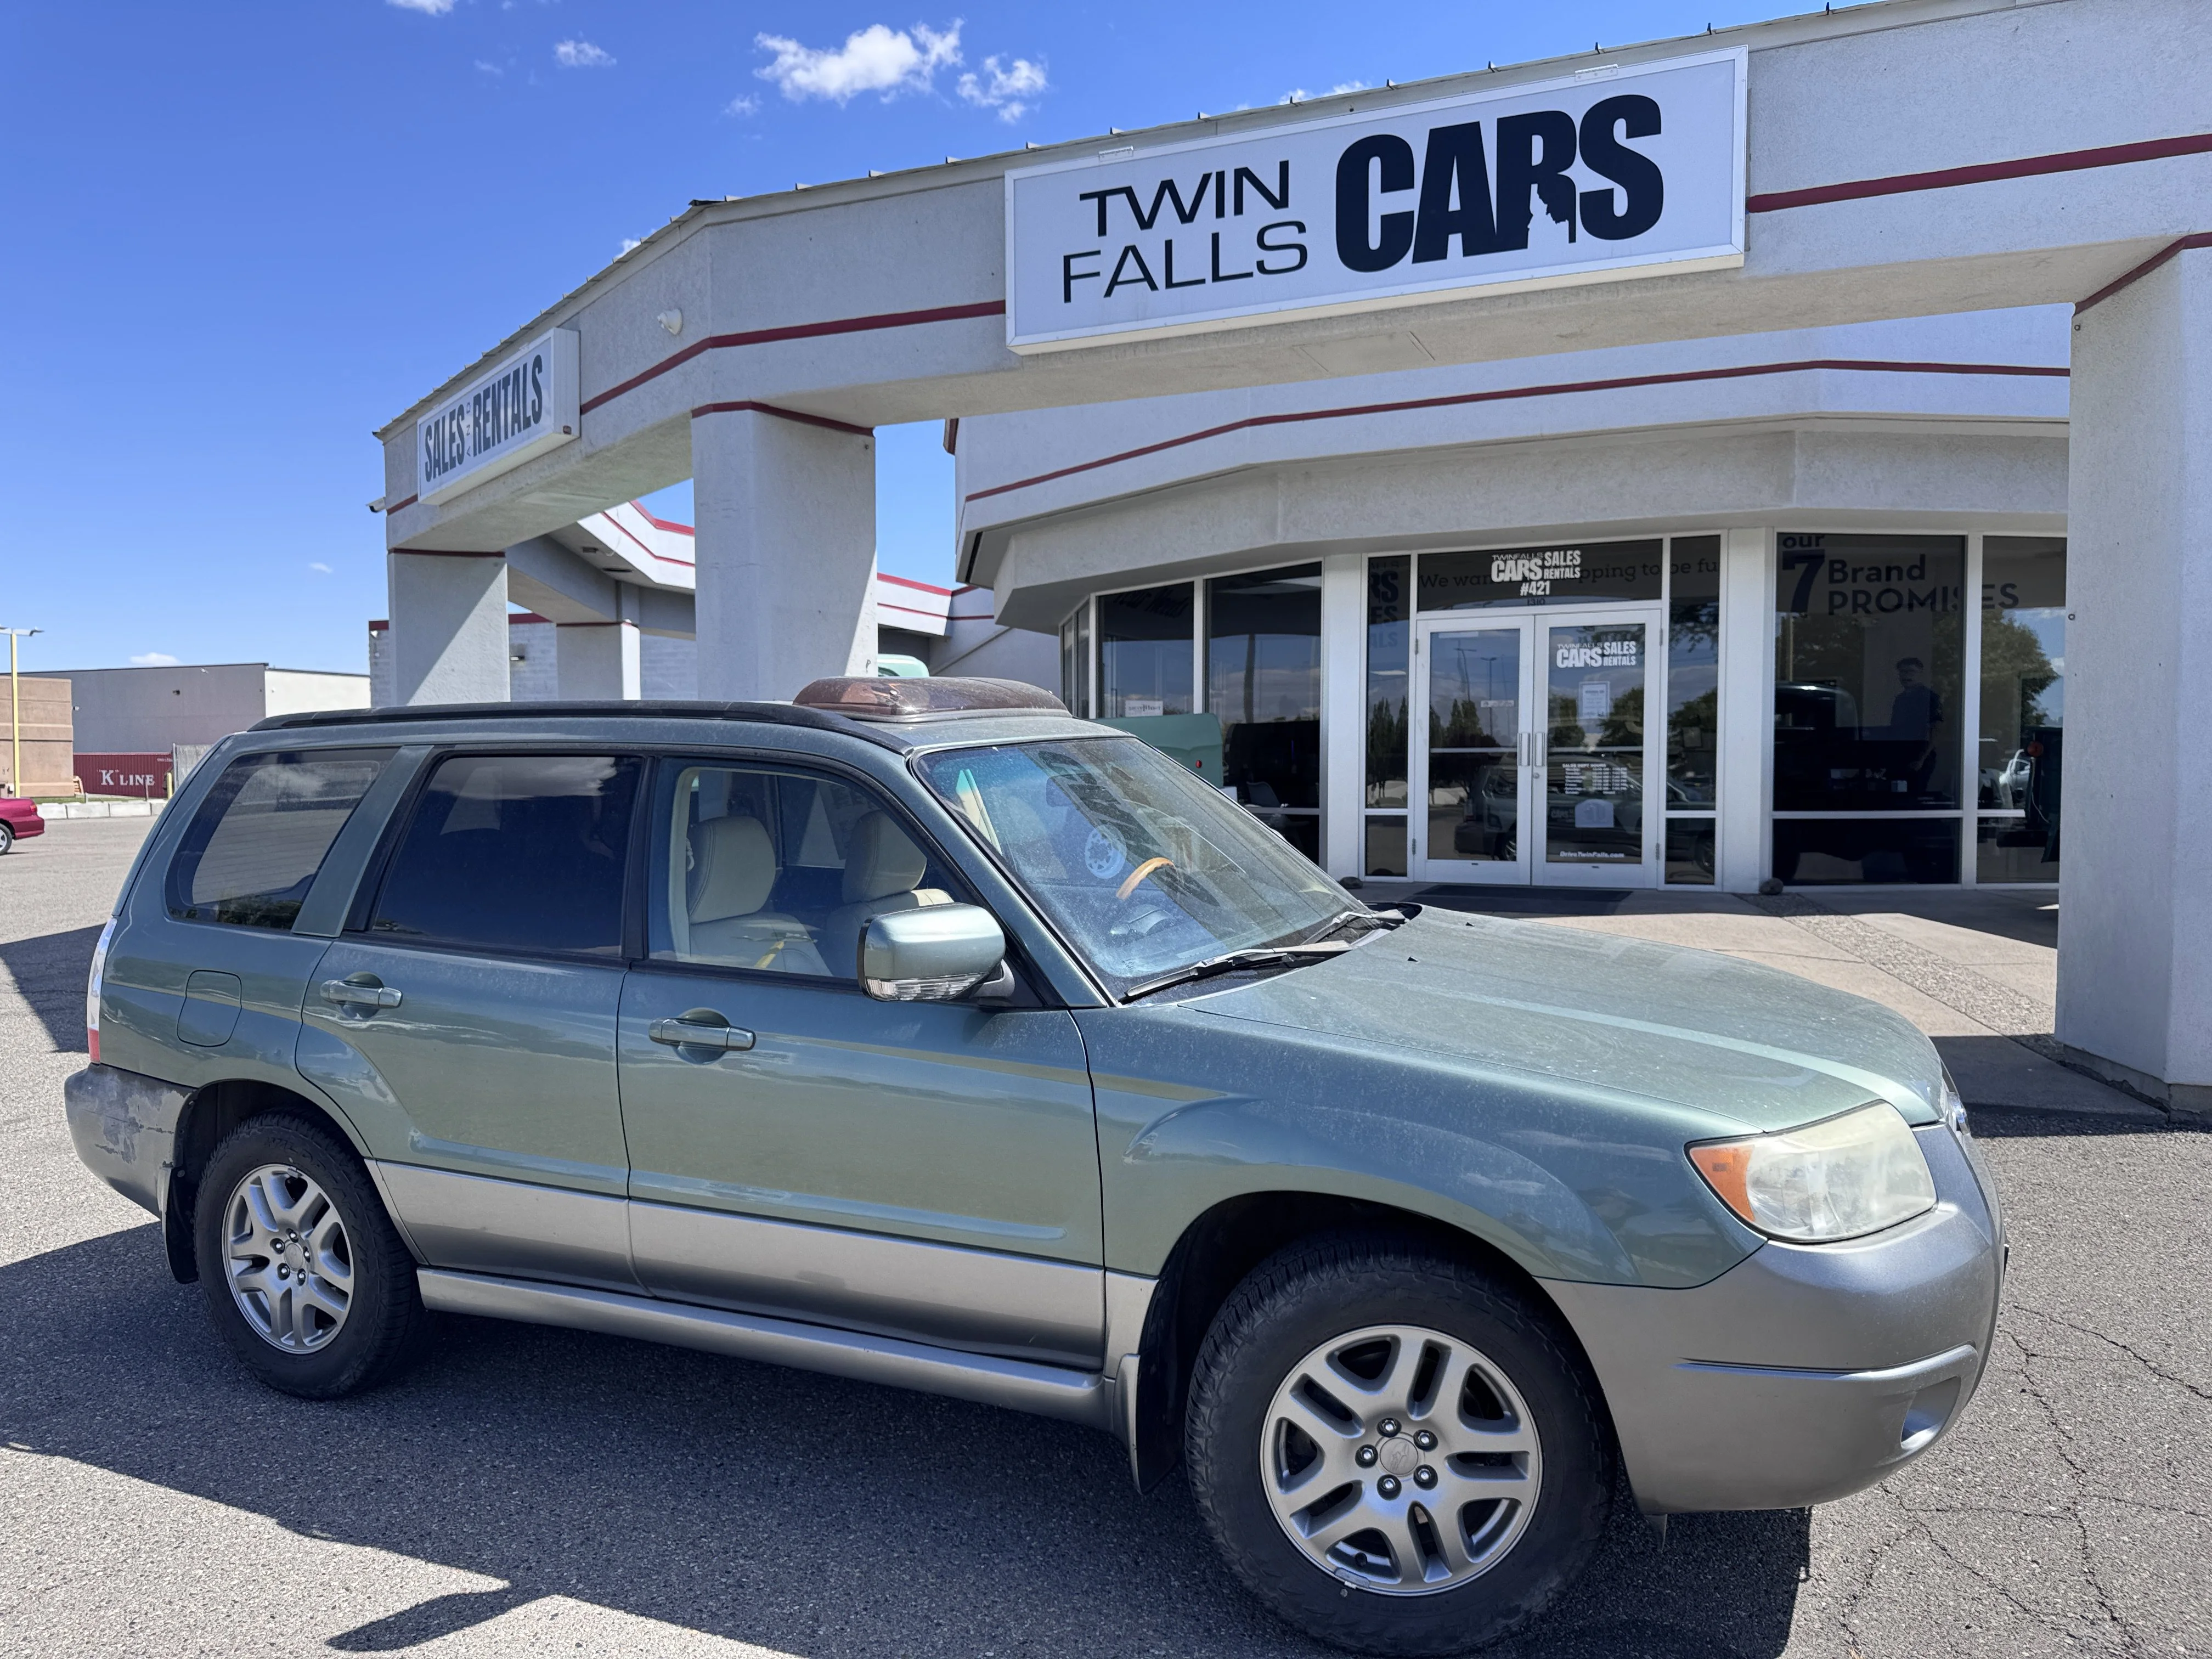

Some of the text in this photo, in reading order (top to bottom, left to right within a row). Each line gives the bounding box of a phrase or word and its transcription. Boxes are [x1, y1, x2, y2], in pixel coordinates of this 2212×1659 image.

[1335, 94, 1664, 273] CARS
[1079, 160, 1289, 238] TWIN
[1063, 221, 1308, 303] FALLS
[425, 404, 465, 483] SALES
[473, 354, 543, 458] RENTALS
[1782, 534, 1825, 549] our
[1544, 550, 1581, 567] SALES
[1828, 554, 1926, 584] Brand
[1420, 573, 1448, 588] We
[1641, 562, 1661, 576] to
[1491, 558, 1543, 582] CARS
[1543, 567, 1581, 579] RENTALS
[1520, 580, 1550, 596] #421
[1782, 550, 1825, 614] 7
[1556, 647, 1602, 668] CARS
[1603, 641, 1637, 655] SALES
[1603, 656, 1637, 667] RENTALS
[120, 774, 155, 786] LINE
